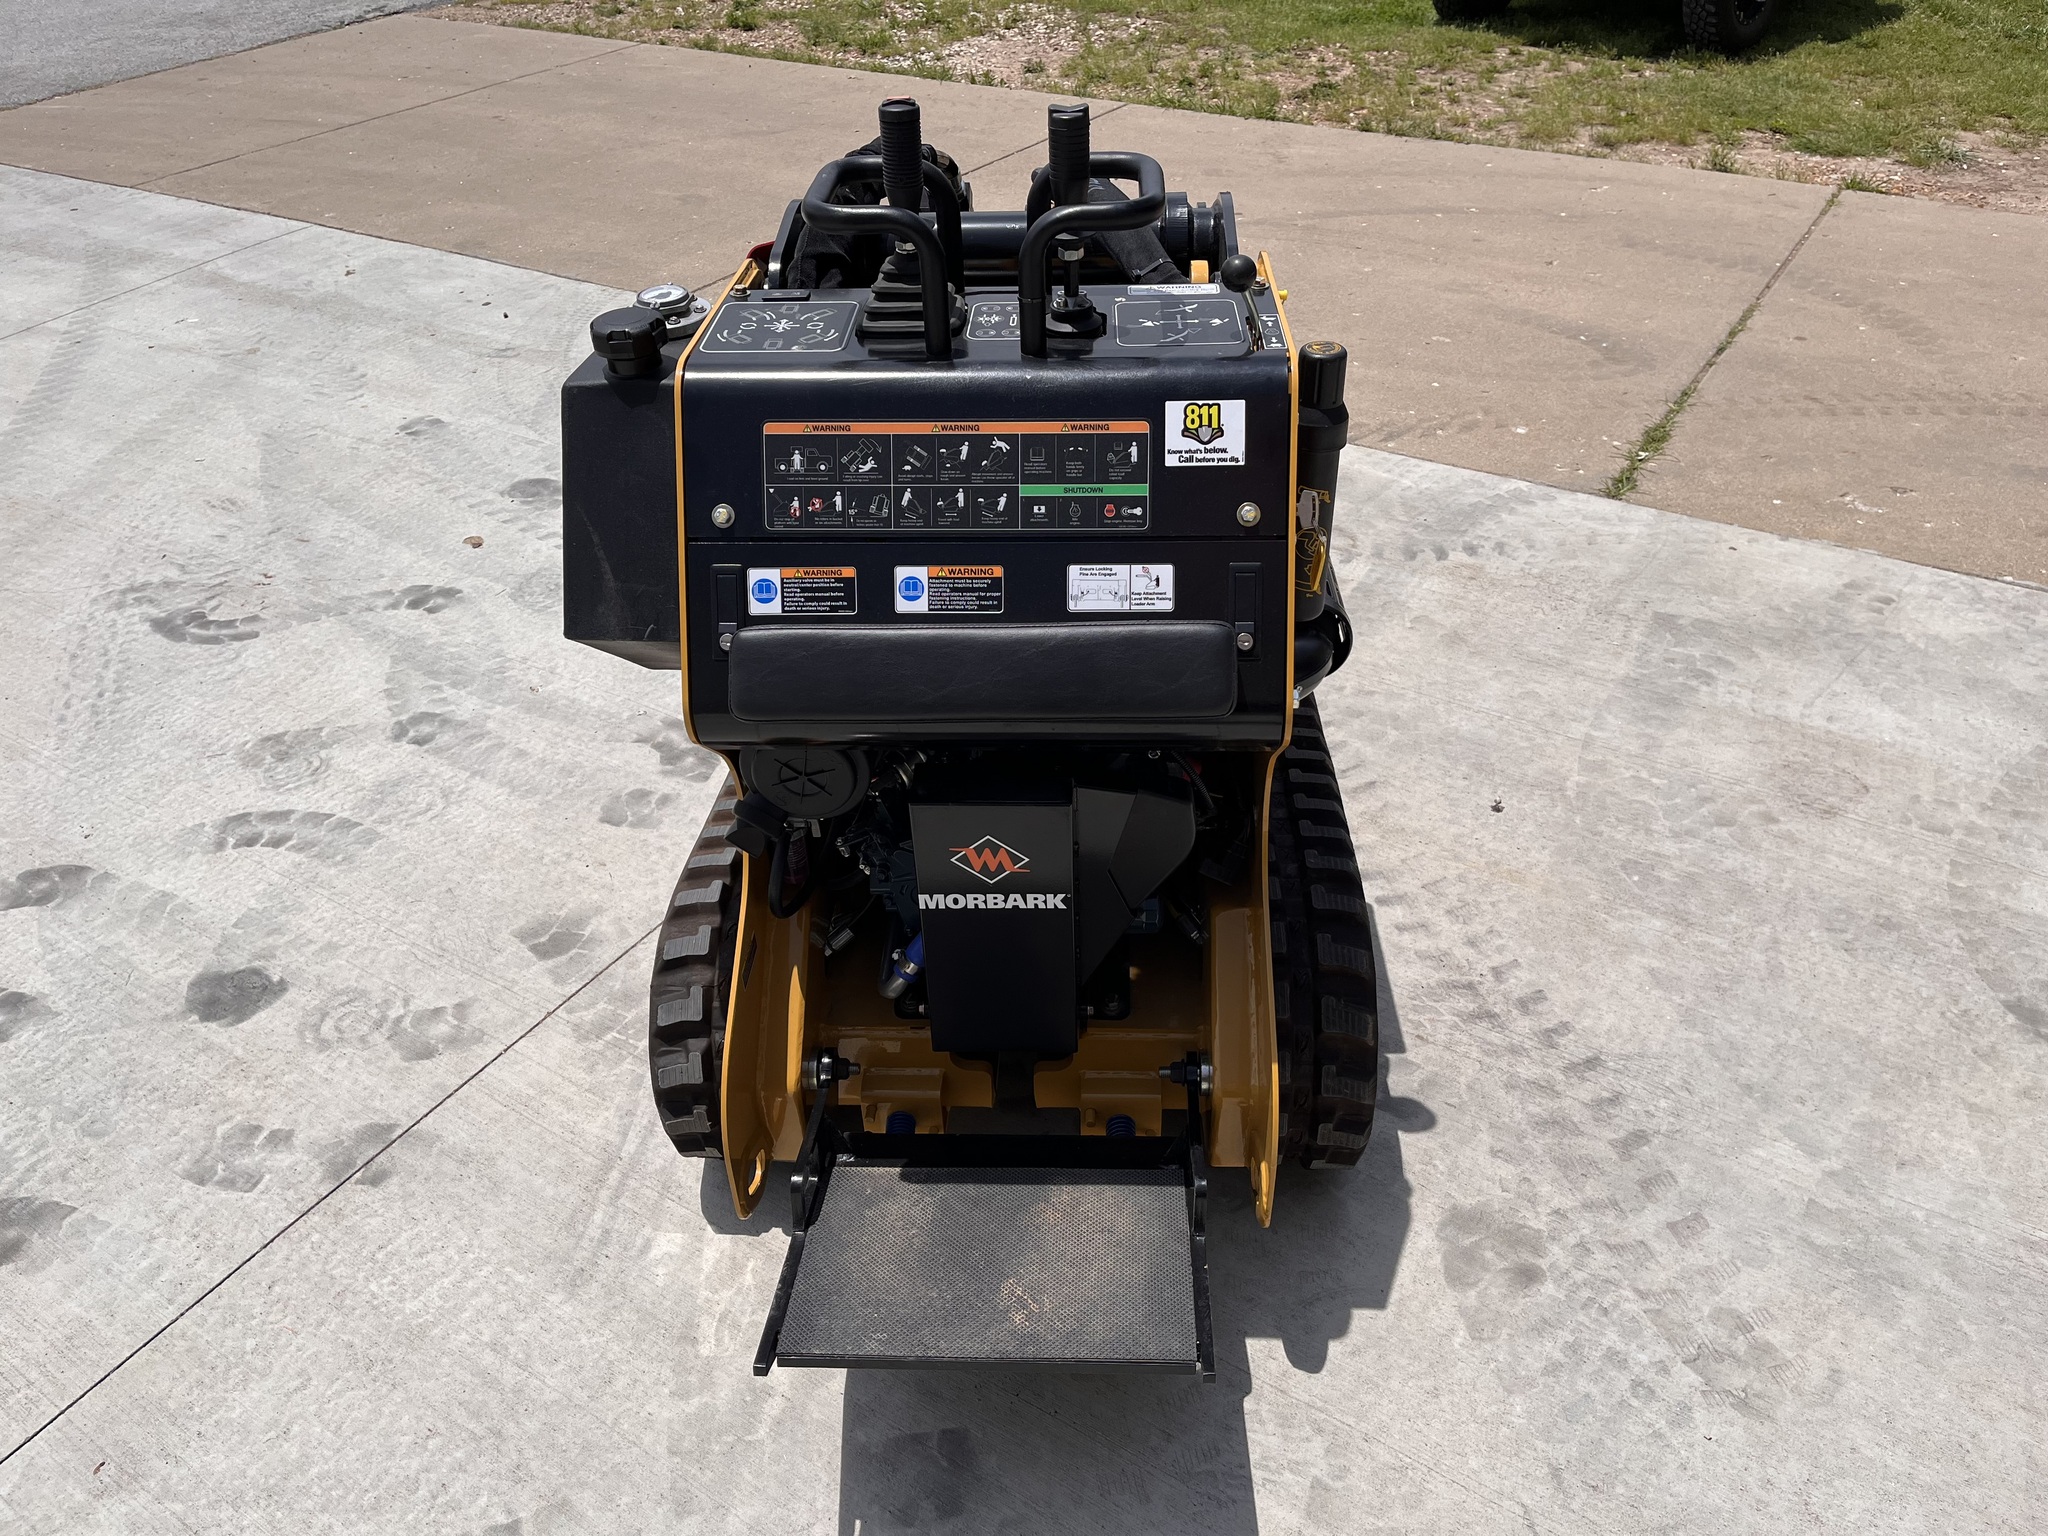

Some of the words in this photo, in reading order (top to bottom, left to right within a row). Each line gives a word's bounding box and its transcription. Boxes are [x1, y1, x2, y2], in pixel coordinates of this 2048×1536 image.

[1185, 404, 1220, 430] 811
[812, 424, 851, 432] WARNING
[940, 424, 980, 432] WARNING
[1070, 423, 1110, 431] WARNING
[1203, 446, 1228, 454] below.
[1178, 455, 1194, 463] Call
[1228, 456, 1241, 464] dig.
[918, 893, 1068, 910] MORBARK
